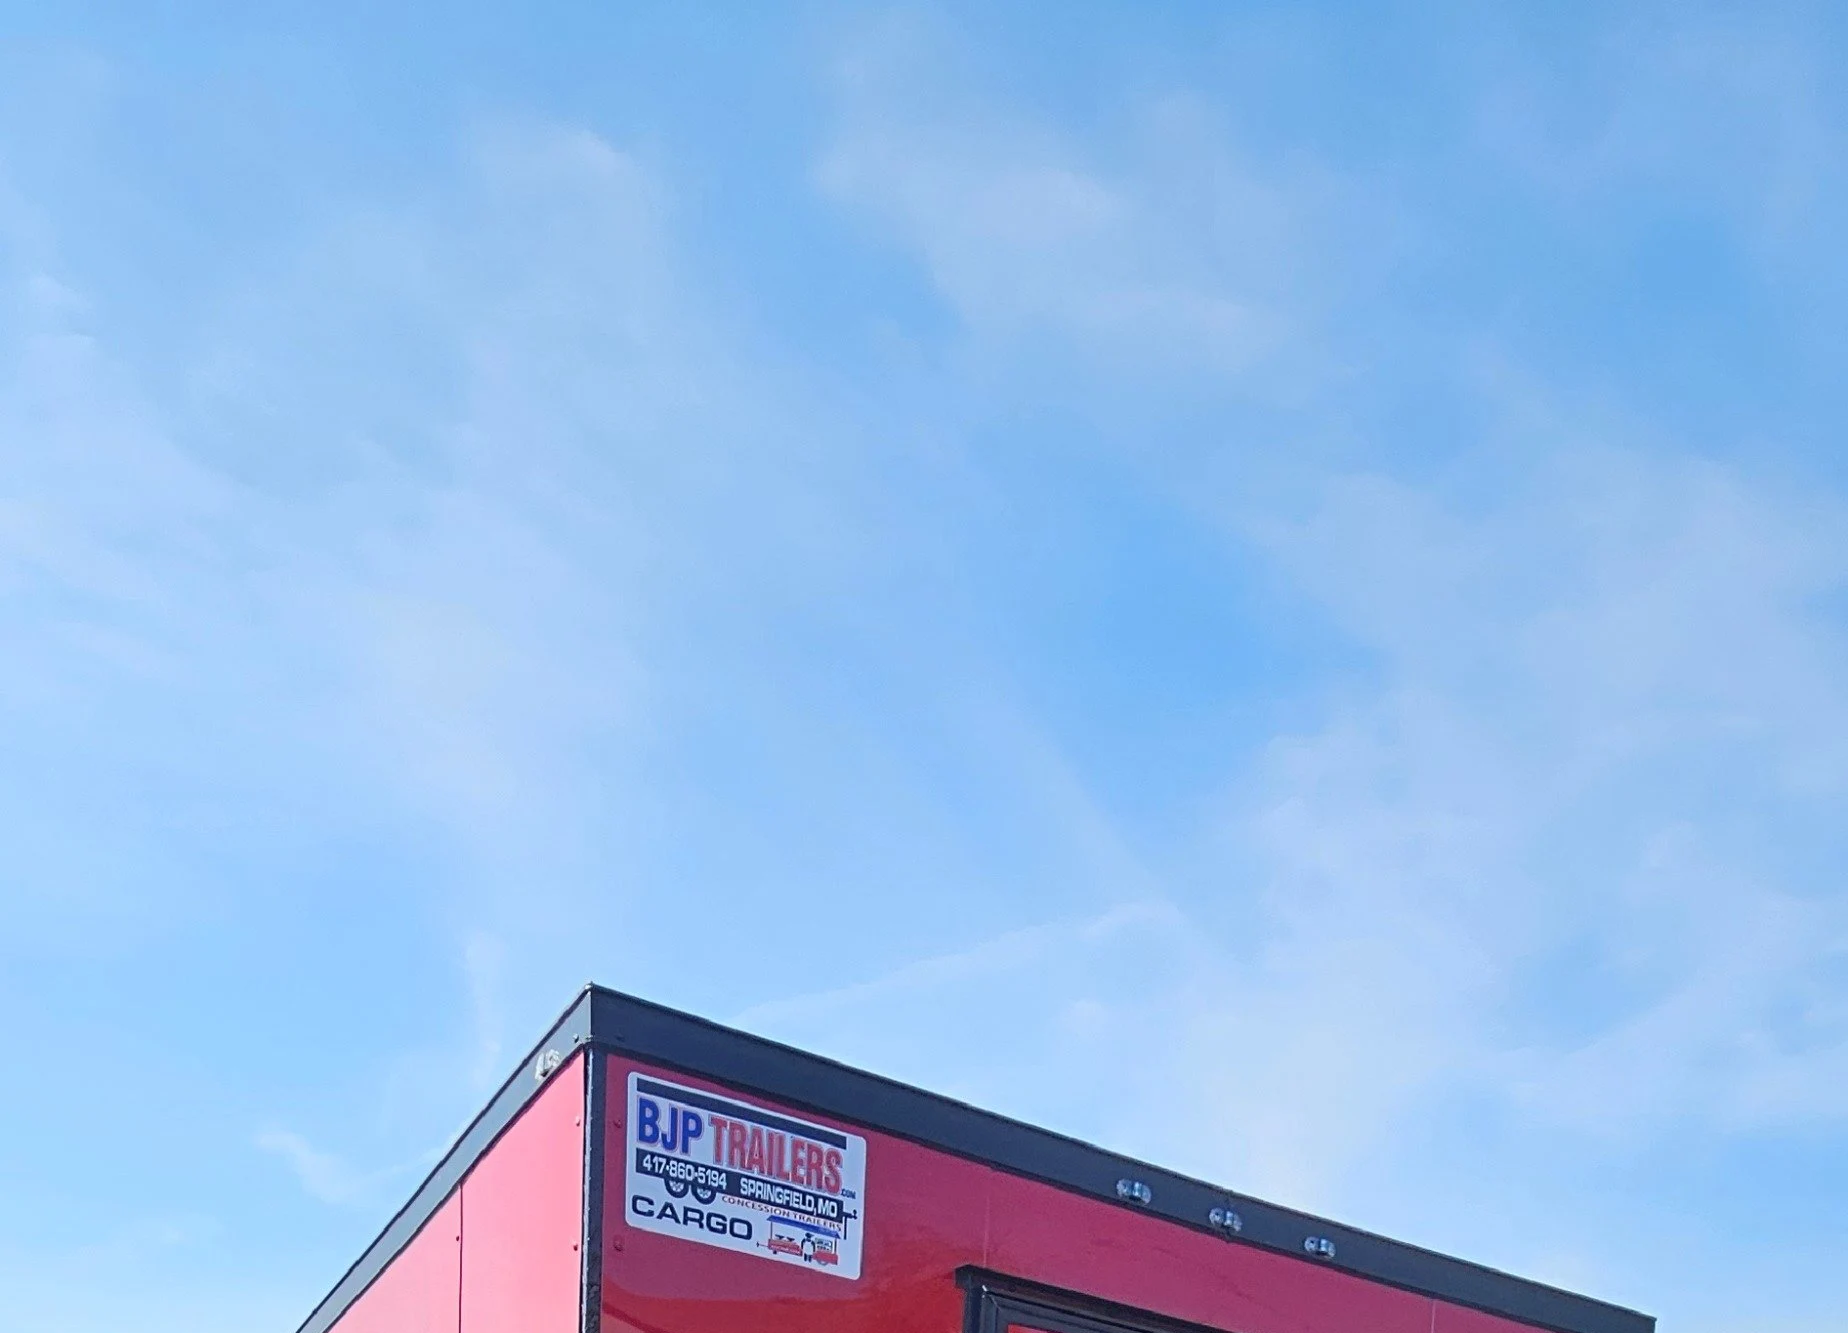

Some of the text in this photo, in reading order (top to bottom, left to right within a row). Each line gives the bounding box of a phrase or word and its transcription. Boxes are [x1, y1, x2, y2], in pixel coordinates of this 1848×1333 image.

[637, 1095, 703, 1156] BJP
[709, 1116, 844, 1196] TRAILERS
[632, 1195, 752, 1240] CARGO
[721, 1196, 842, 1231] CONCESSION TRAILERS
